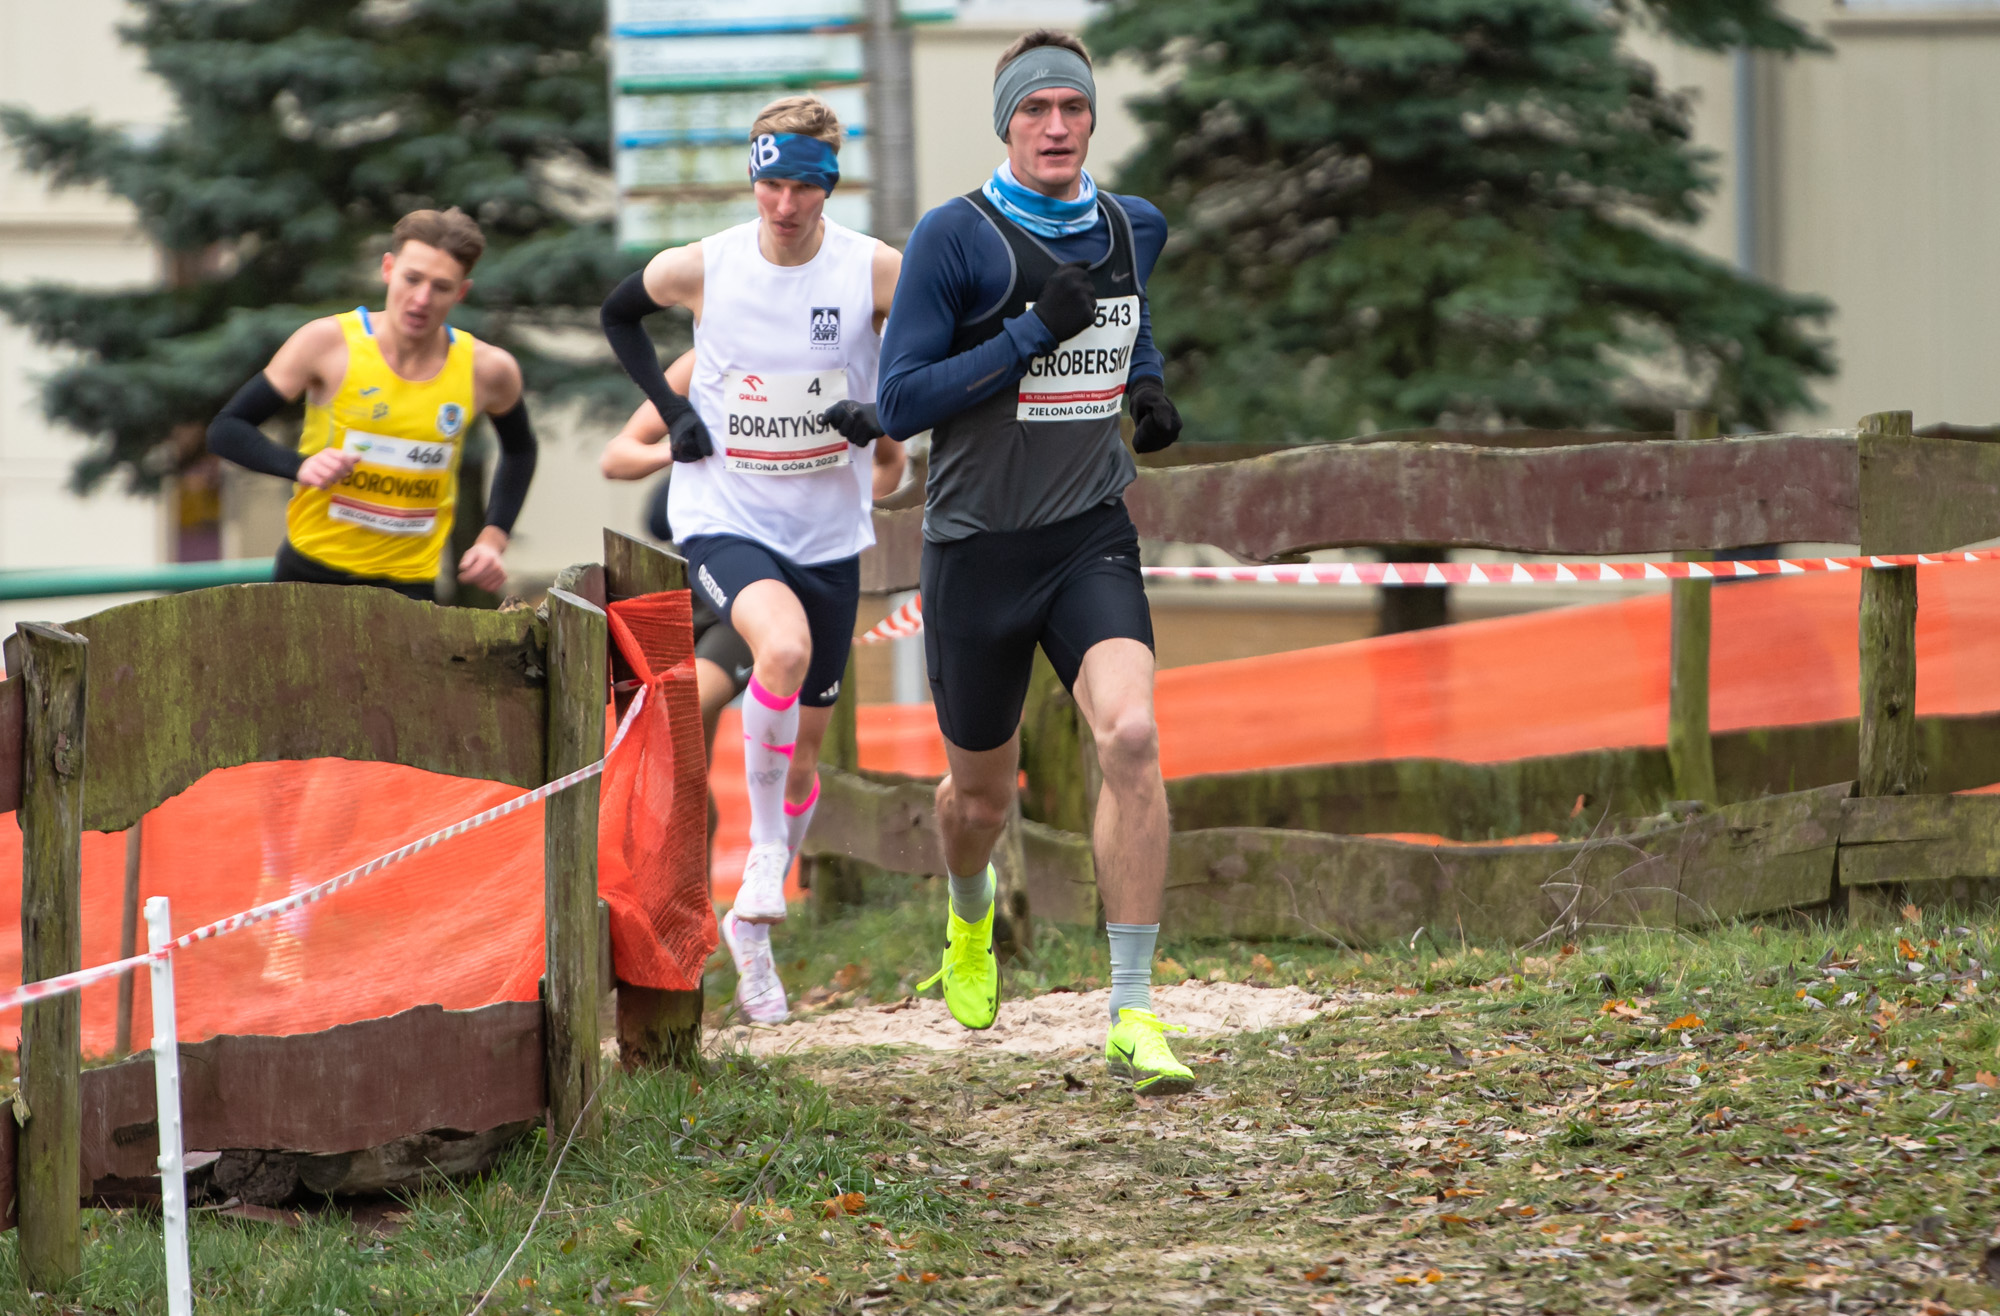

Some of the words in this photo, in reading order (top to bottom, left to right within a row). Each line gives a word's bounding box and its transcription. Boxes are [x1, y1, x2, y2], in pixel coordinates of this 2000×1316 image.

[1094, 303, 1131, 328] 543
[812, 323, 838, 333] AZS
[812, 332, 838, 341] AWF
[1029, 345, 1130, 377] GROBERSKI
[807, 377, 822, 396] 4
[738, 393, 768, 403] ORLEN
[1028, 406, 1074, 417] ZIELONA
[1075, 402, 1105, 415] GÓRA
[729, 410, 836, 438] BORATYŃS
[407, 446, 443, 464] 466
[735, 460, 779, 471] ZIELONA
[781, 461, 813, 471] GÓRA
[815, 454, 839, 467] 2023
